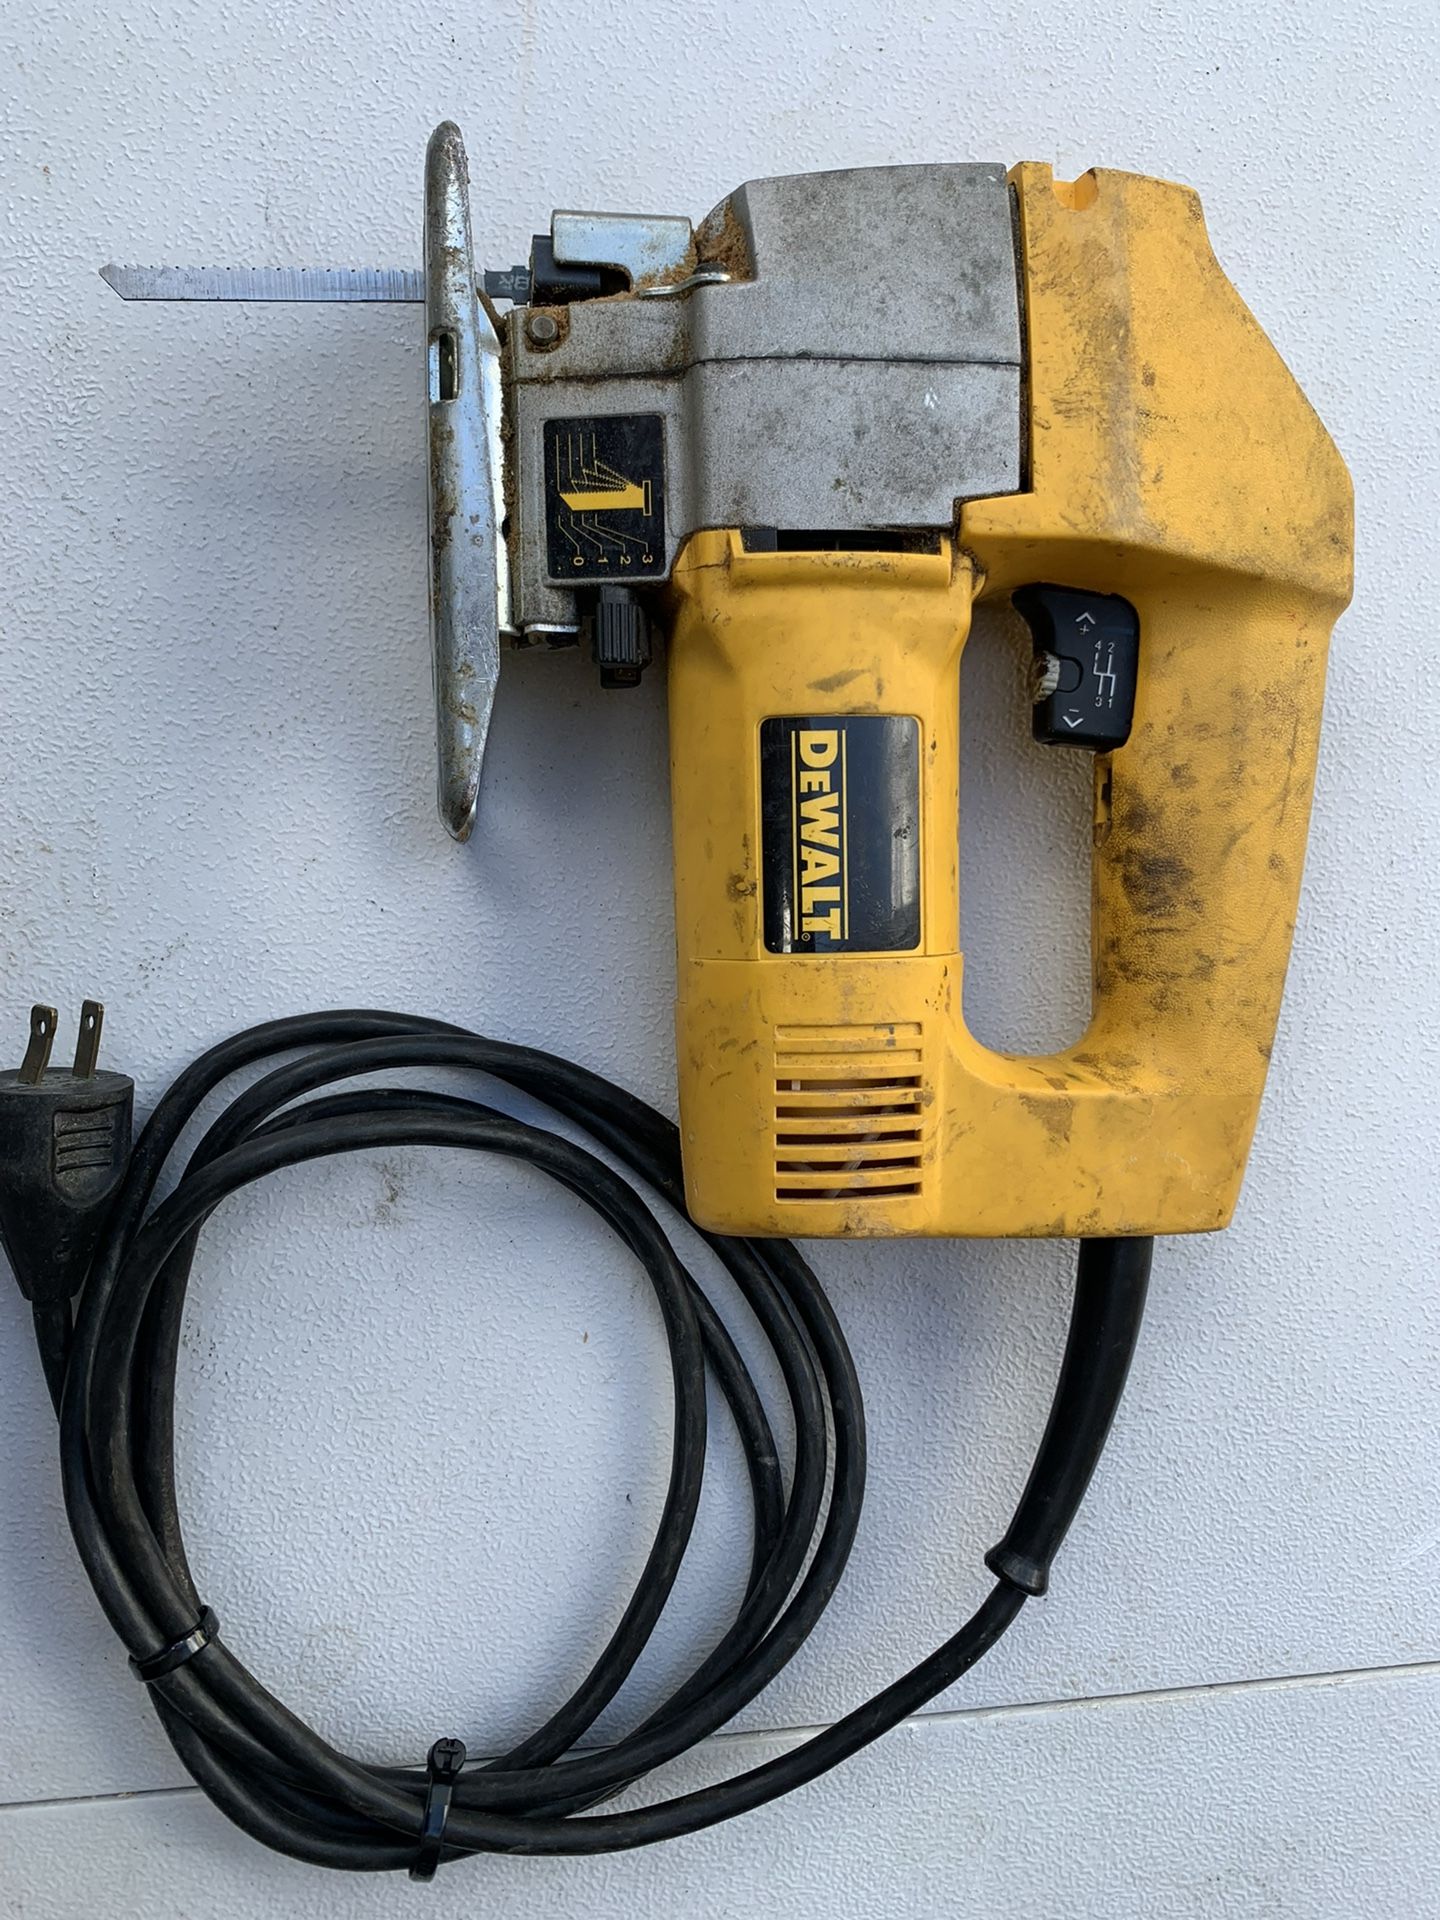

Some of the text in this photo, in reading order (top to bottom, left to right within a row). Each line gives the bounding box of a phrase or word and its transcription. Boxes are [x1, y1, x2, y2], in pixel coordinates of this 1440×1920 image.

[573, 556, 585, 566] 0
[620, 555, 631, 565] 2
[642, 554, 653, 564] 3
[1094, 640, 1115, 653] 4 2
[1095, 696, 1113, 709] 3 1
